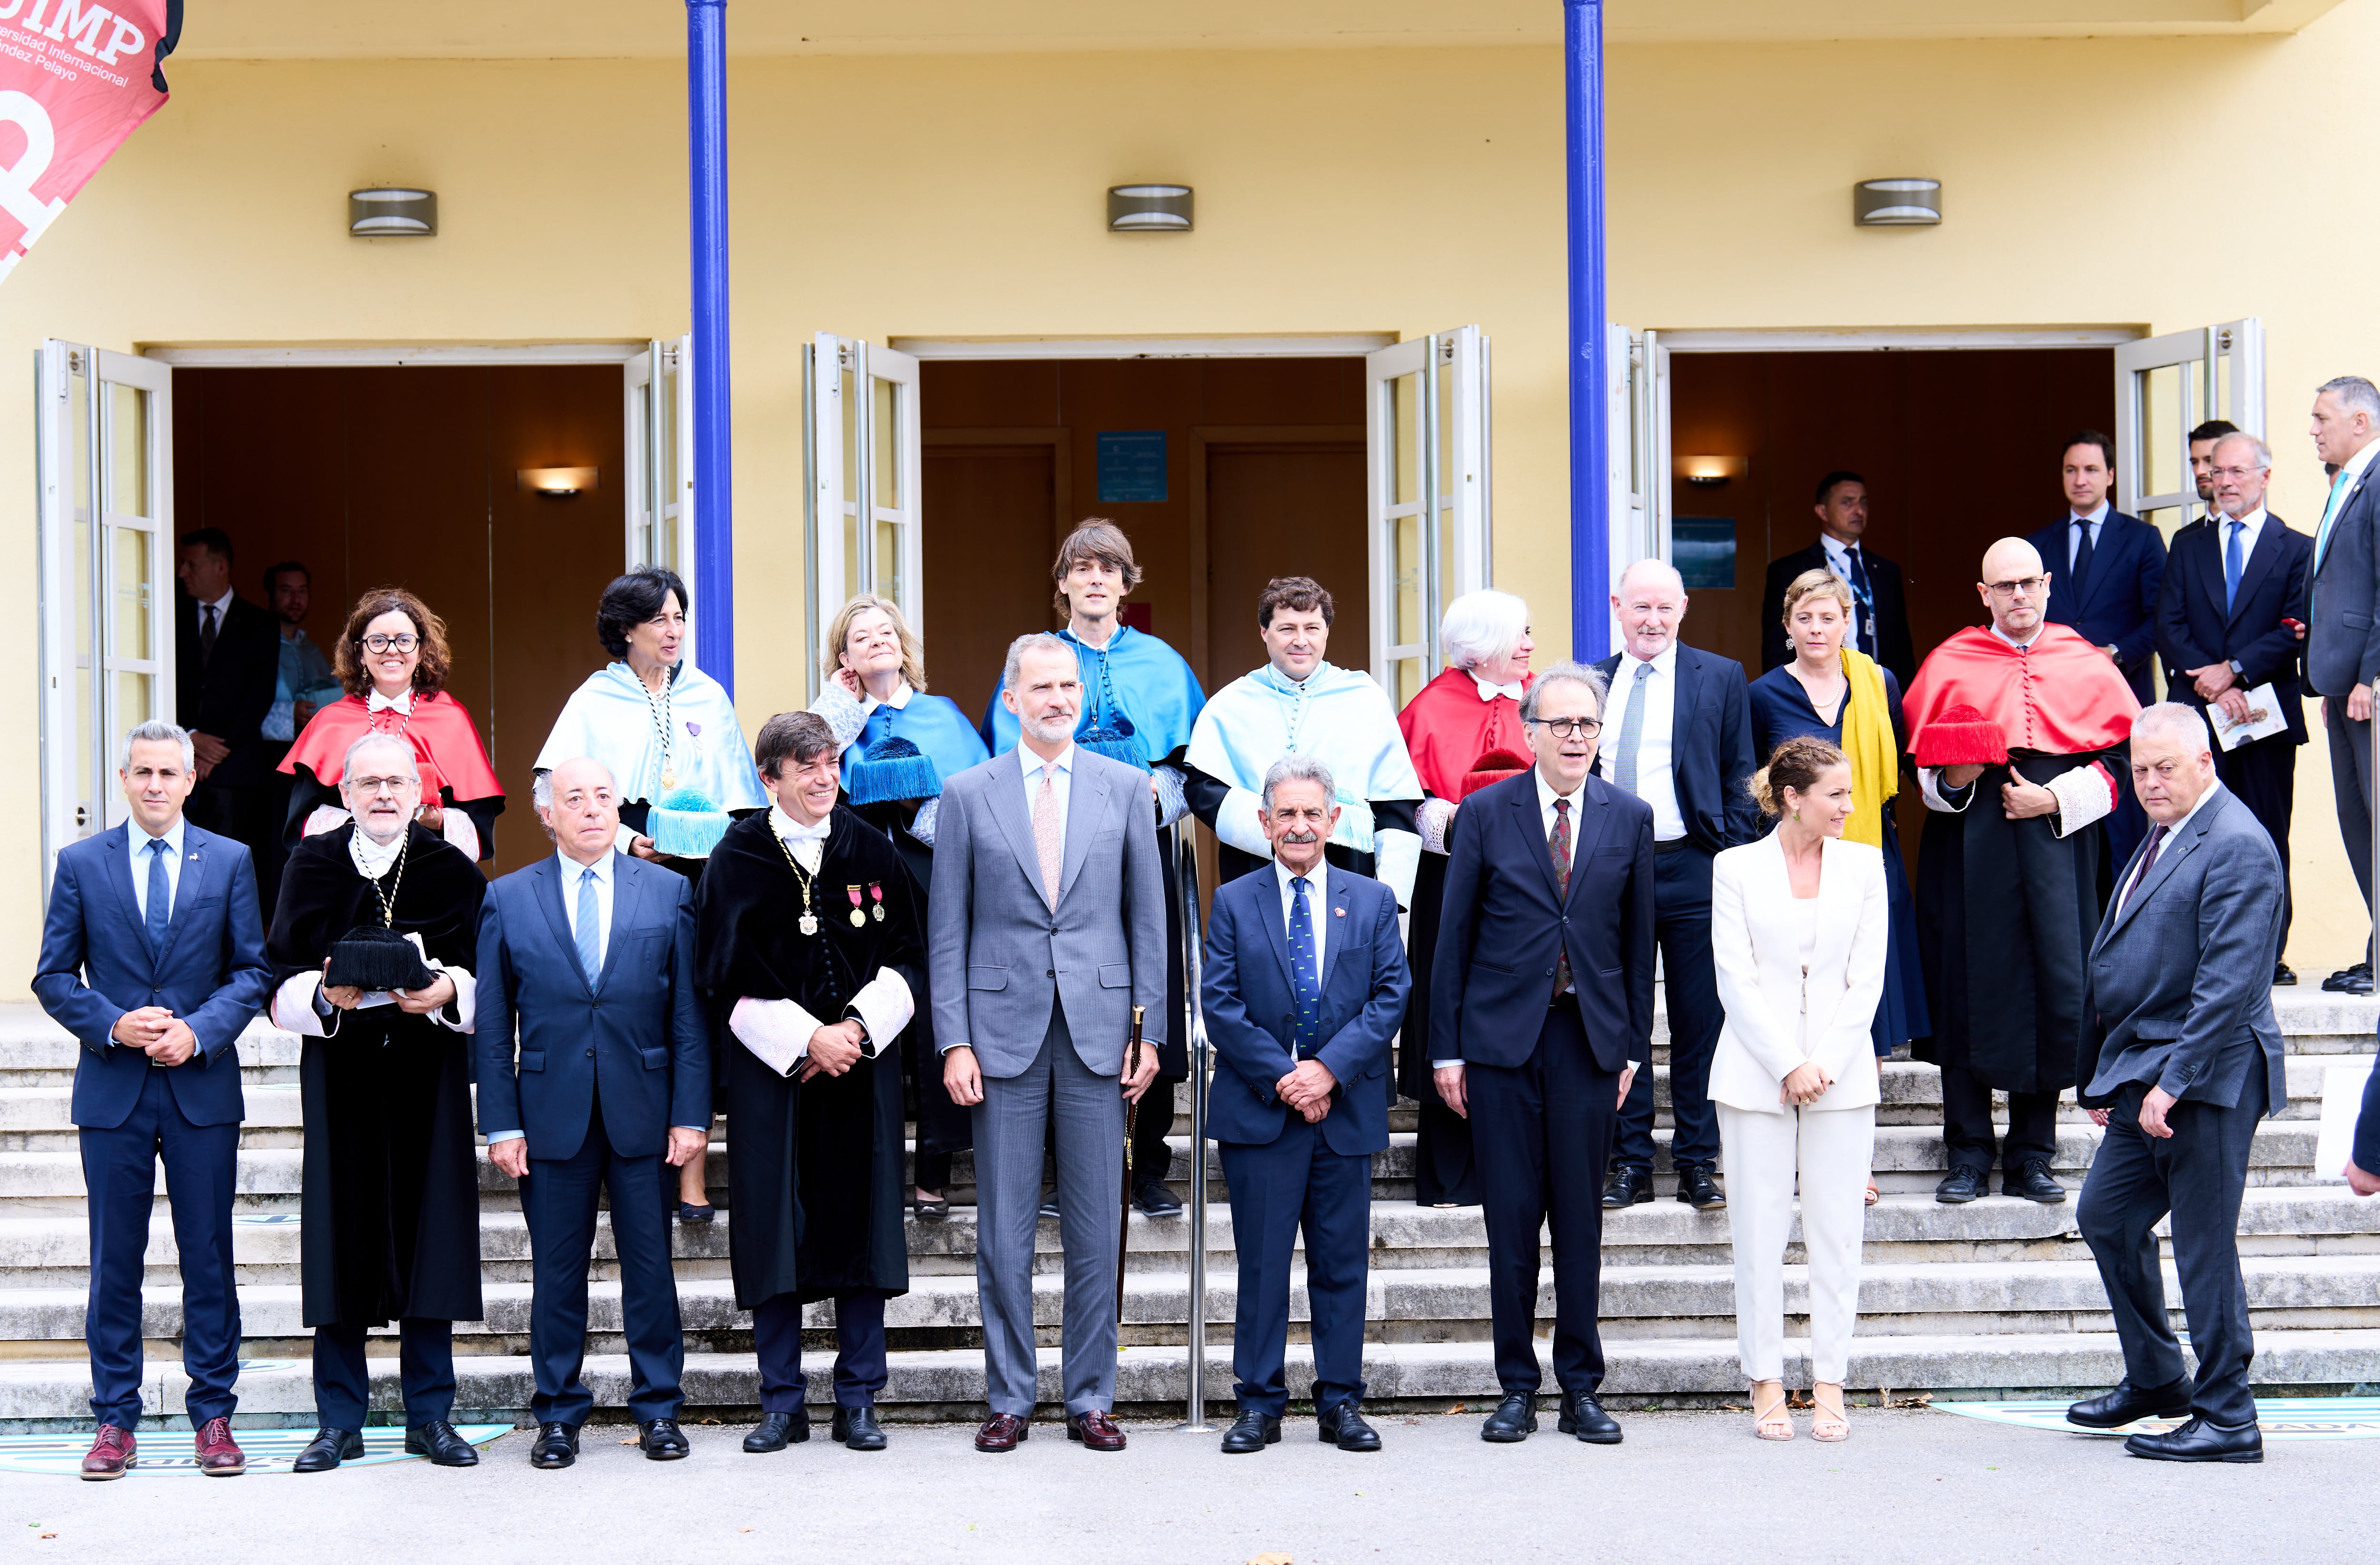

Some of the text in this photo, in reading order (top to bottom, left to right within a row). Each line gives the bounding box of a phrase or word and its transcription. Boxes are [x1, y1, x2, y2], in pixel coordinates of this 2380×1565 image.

[0, 26, 129, 88] ersidad Internacional
[35, 54, 77, 81] Pelayo
